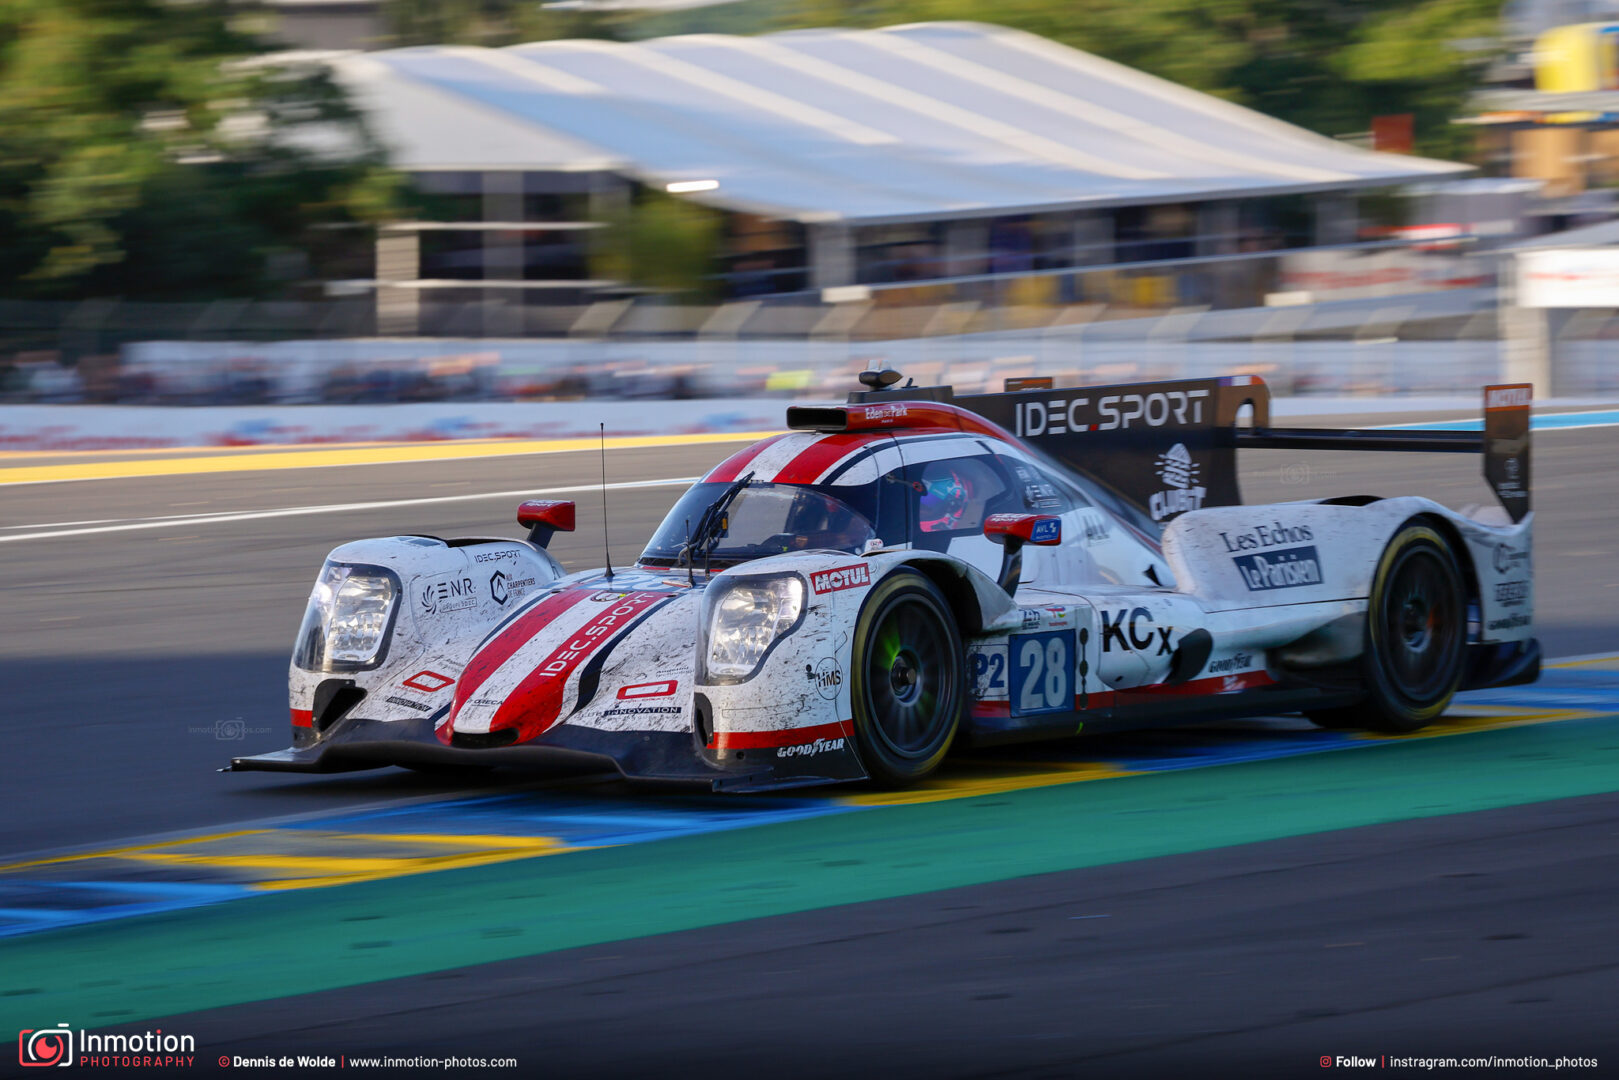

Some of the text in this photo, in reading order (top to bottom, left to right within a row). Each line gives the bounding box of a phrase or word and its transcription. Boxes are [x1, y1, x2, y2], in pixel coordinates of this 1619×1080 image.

[865, 404, 908, 420] Eden Park
[1219, 521, 1314, 553] Les Echos
[507, 577, 536, 590] CHARPENTIERS
[815, 566, 869, 592] MOTUL
[1253, 554, 1320, 588] Parisien
[817, 670, 842, 688] HMS
[969, 653, 1005, 689] P2
[1019, 637, 1068, 710] 28
[605, 707, 680, 715] INNOVATION
